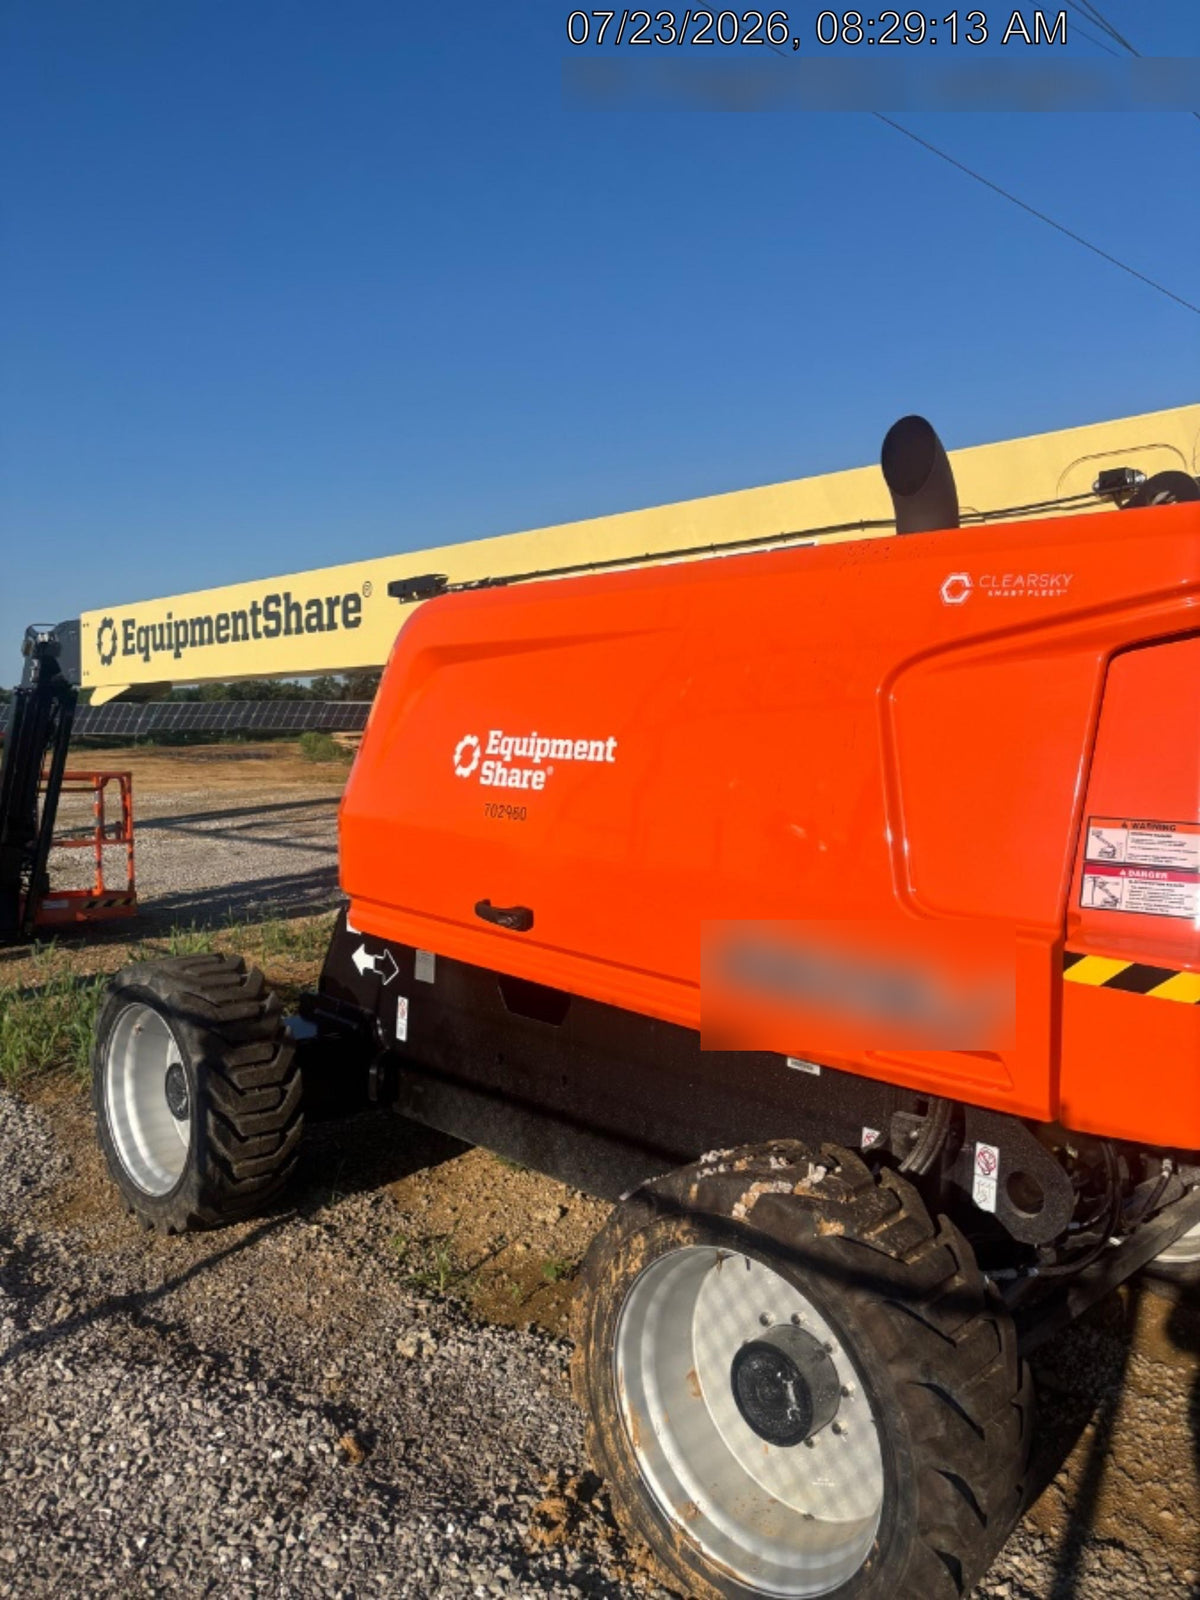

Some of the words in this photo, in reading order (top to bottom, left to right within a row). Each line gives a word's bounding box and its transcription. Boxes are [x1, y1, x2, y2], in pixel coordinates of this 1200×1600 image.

[979, 574, 1073, 588] CLEARSKY
[485, 730, 617, 763] Equipment
[1131, 822, 1176, 832] WARNING
[1128, 869, 1168, 880] DANGER
